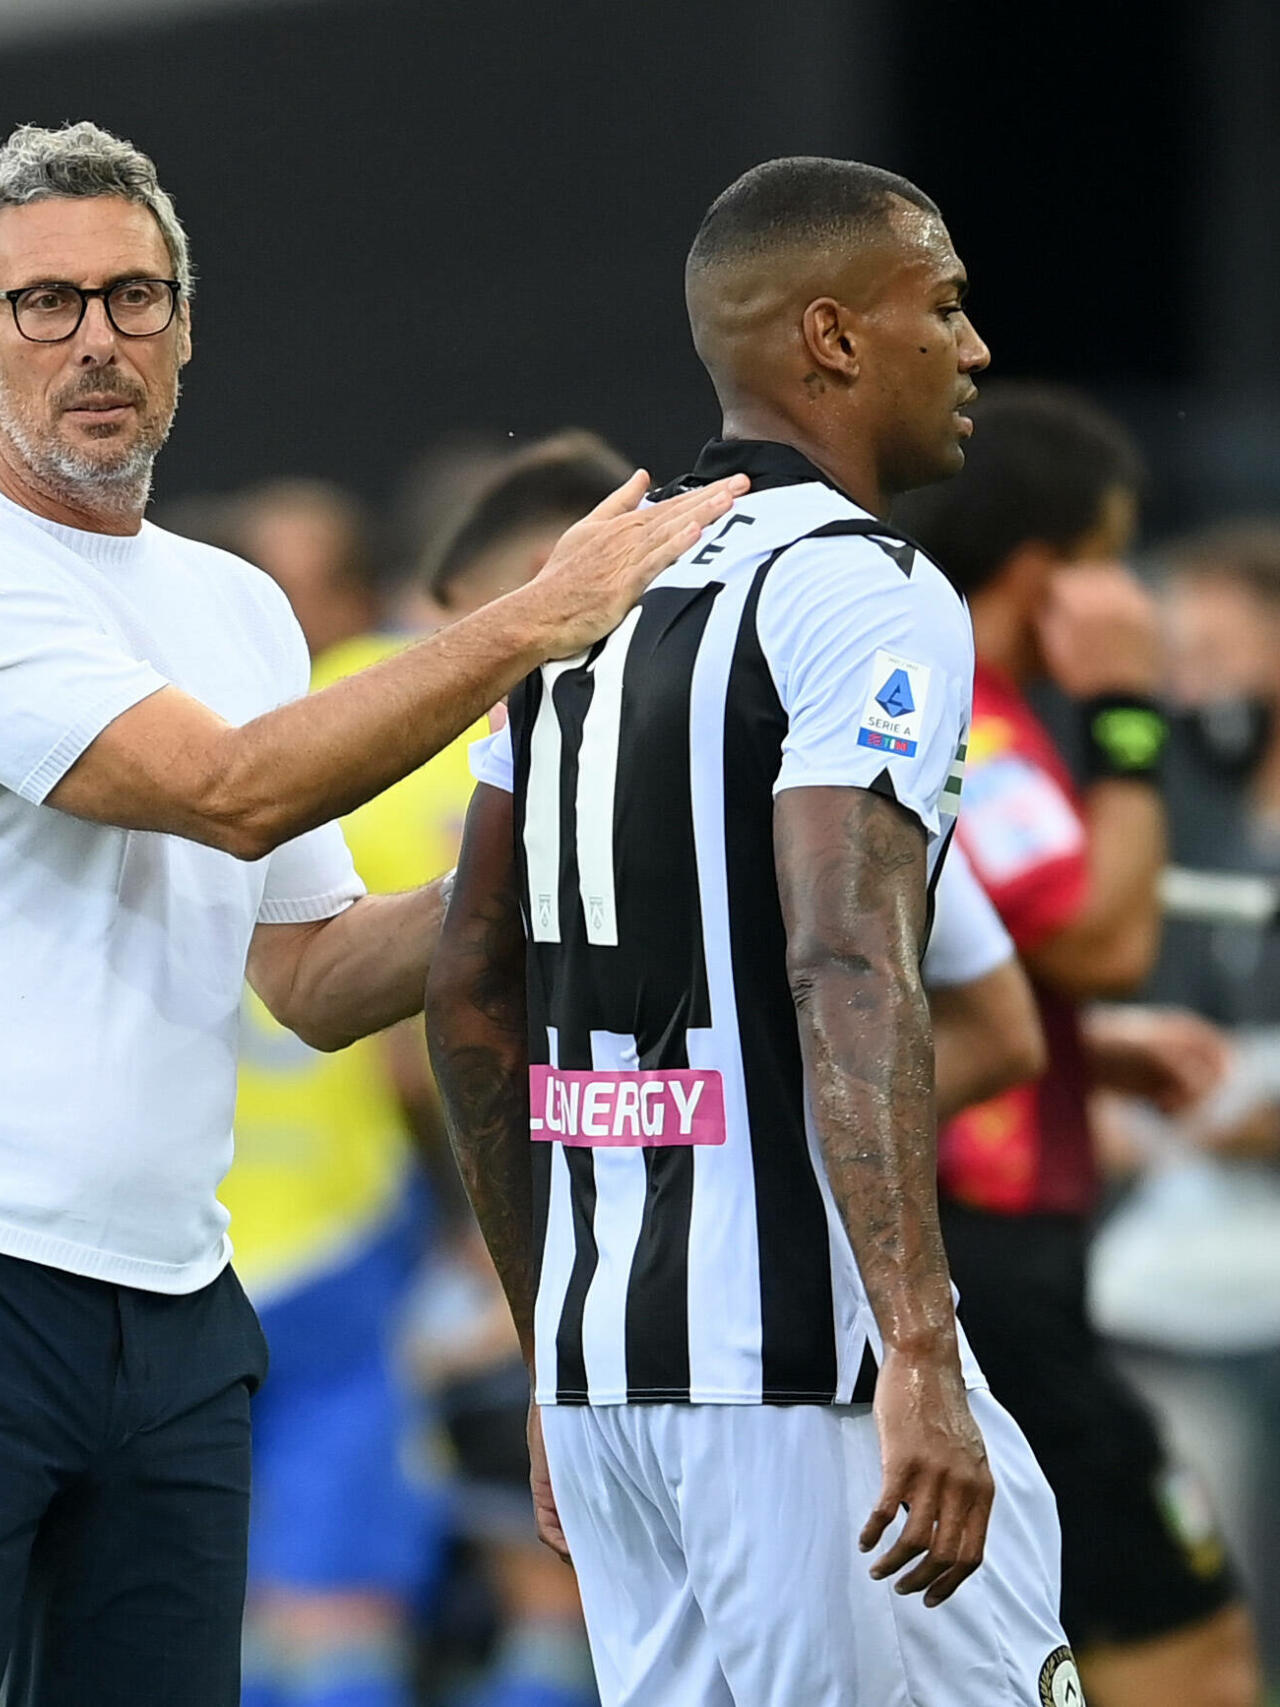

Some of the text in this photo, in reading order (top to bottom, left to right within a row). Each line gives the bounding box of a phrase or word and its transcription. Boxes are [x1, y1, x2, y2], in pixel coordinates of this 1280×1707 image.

[523, 605, 643, 946] 11
[868, 717, 911, 736] SERIE A
